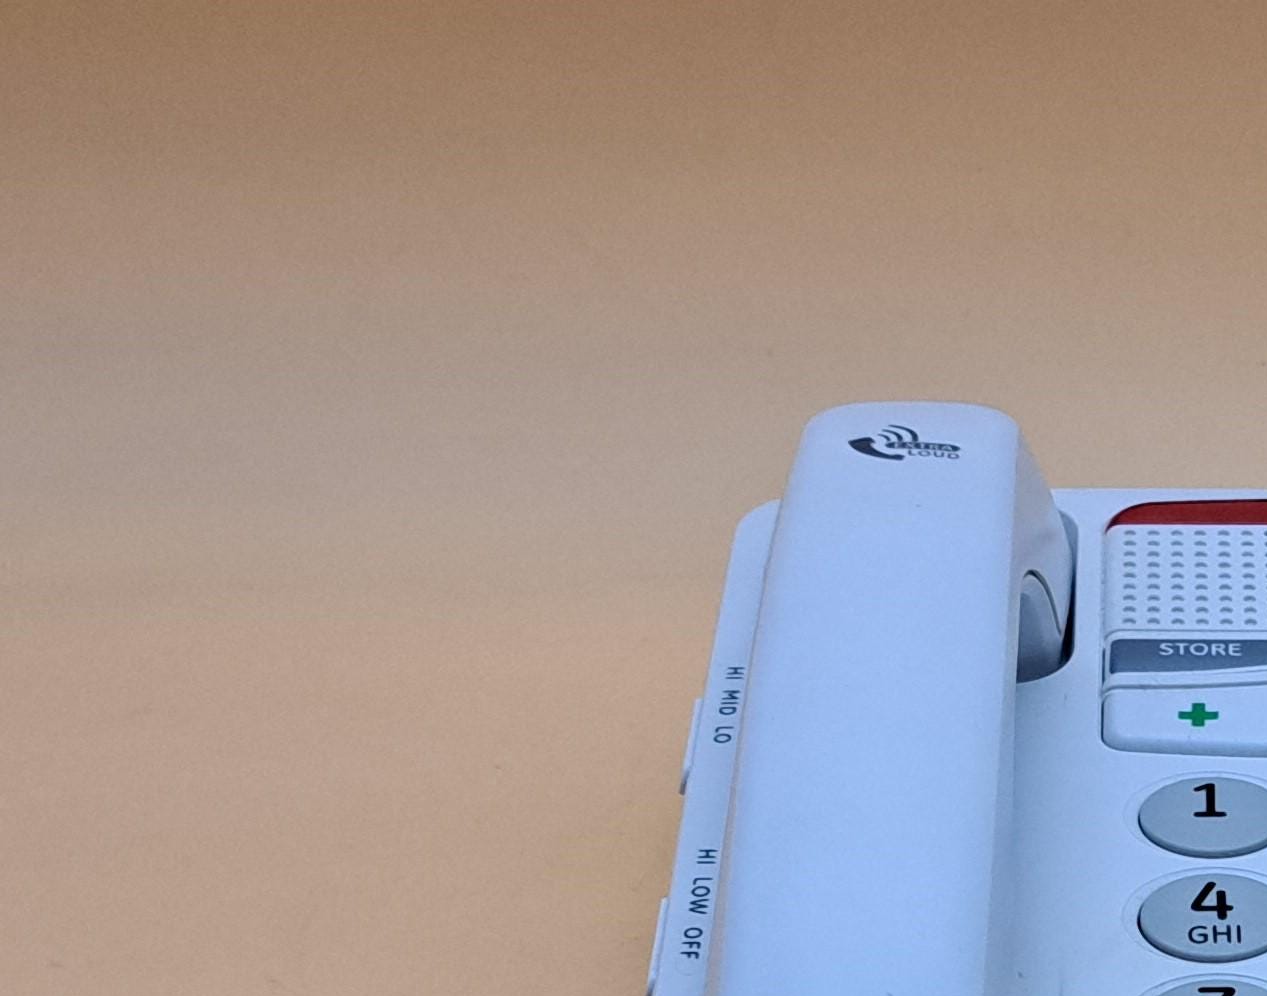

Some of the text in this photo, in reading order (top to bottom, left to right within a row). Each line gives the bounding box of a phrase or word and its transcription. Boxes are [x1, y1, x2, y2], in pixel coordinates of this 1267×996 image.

[907, 448, 960, 460] LOUD
[1159, 642, 1242, 656] STORE
[713, 666, 745, 744] HI MID LO
[1193, 783, 1227, 818] 1
[681, 849, 718, 960] HI LOW OFF
[1190, 881, 1234, 920] 4
[1187, 924, 1242, 945] GHI
